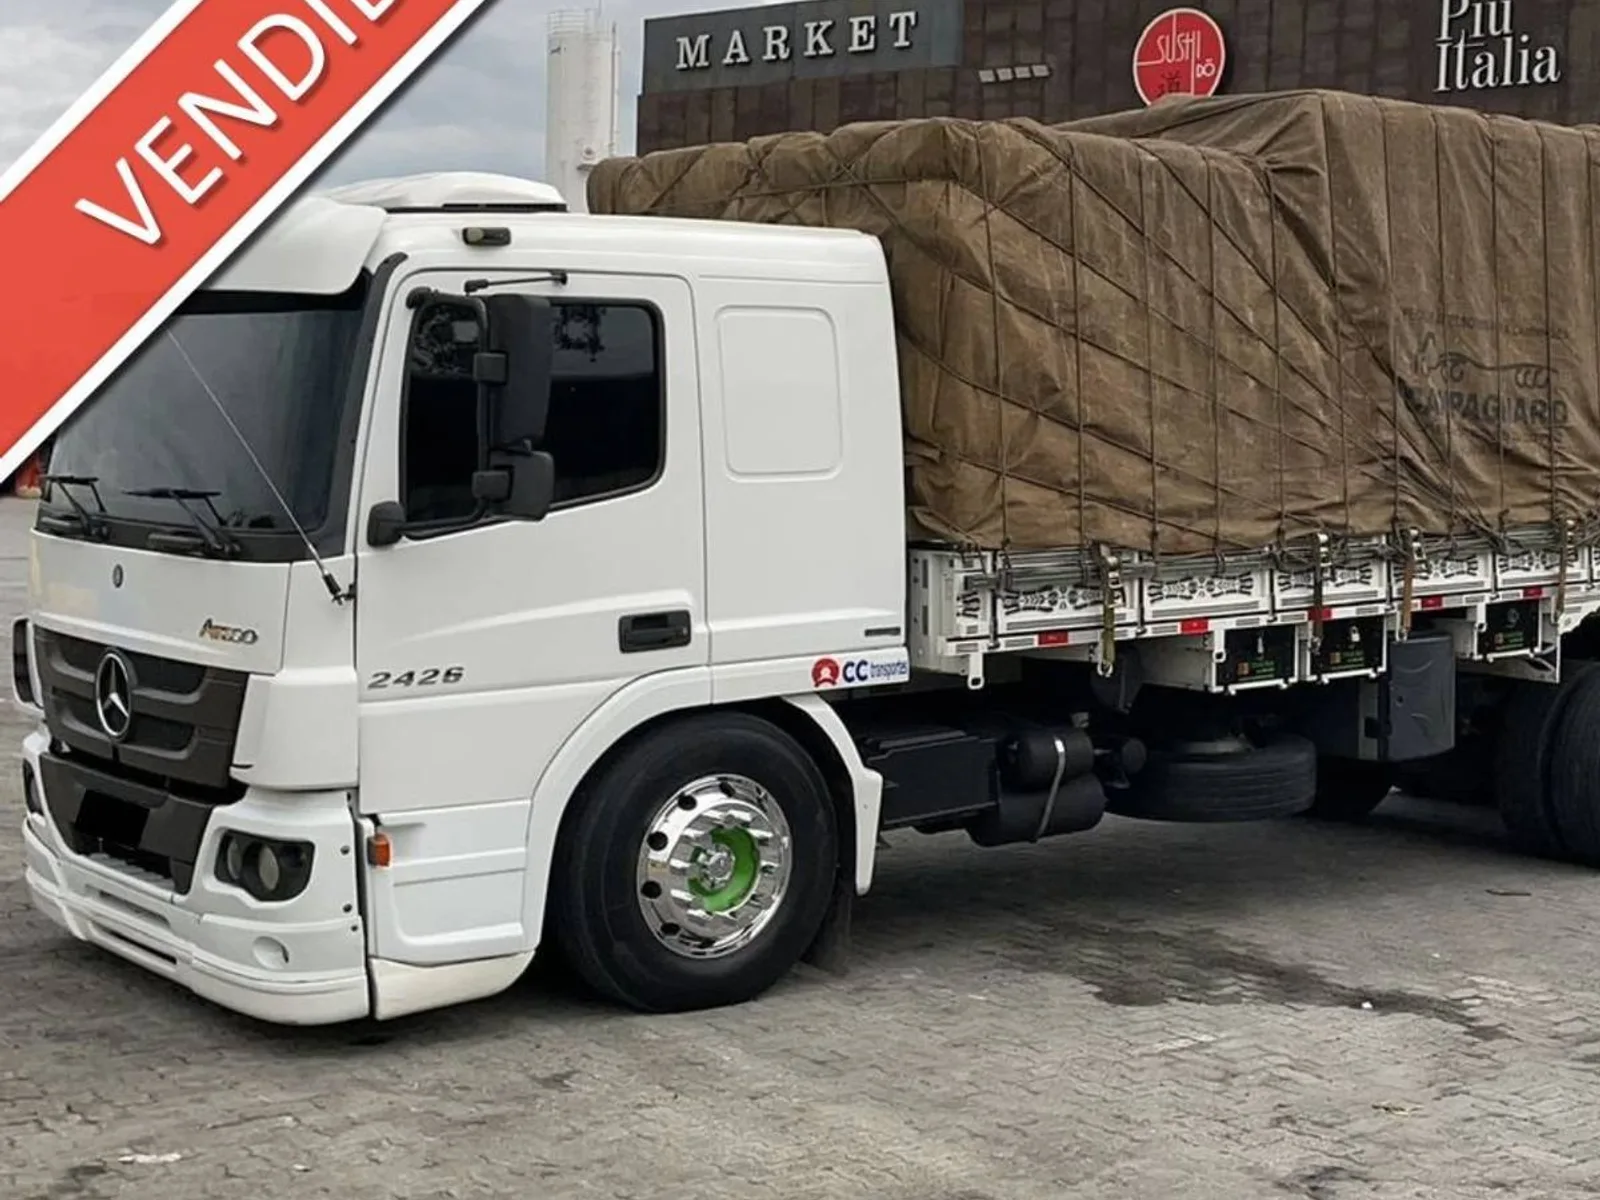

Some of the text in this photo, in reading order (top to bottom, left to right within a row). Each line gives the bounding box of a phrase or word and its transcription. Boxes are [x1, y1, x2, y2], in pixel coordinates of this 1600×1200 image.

[676, 11, 918, 70] MARKET
[1150, 27, 1202, 64] SUSHI
[1433, 29, 1561, 93] Italia
[367, 666, 464, 690] 2426
[842, 660, 869, 683] CC
